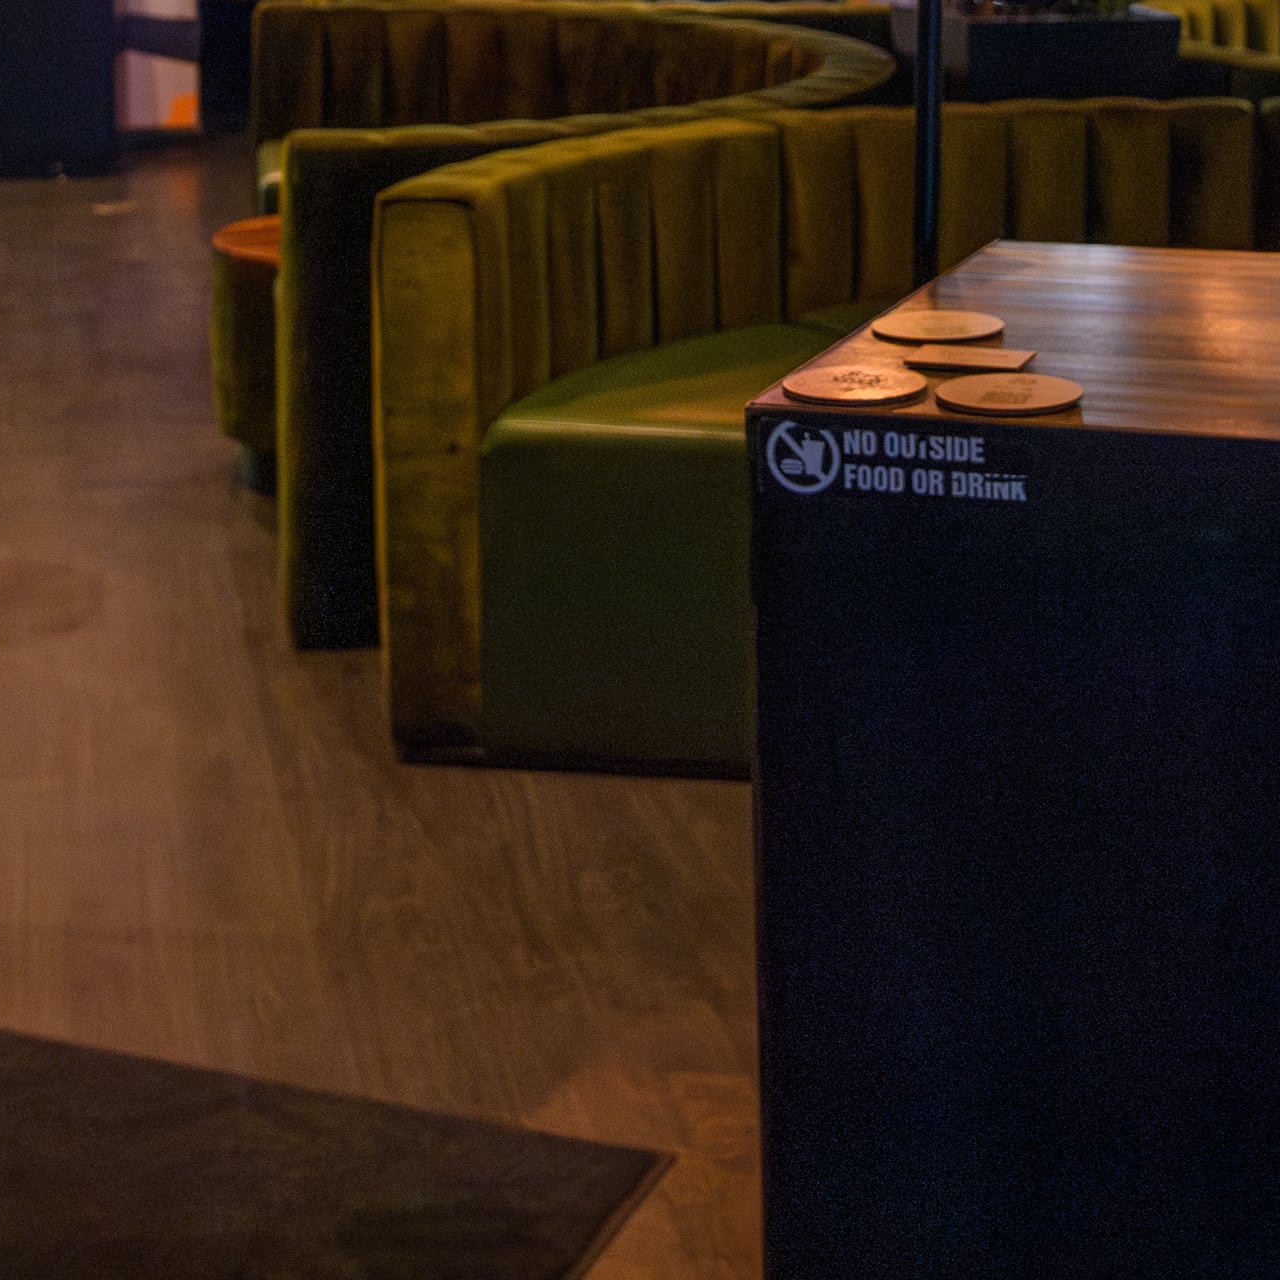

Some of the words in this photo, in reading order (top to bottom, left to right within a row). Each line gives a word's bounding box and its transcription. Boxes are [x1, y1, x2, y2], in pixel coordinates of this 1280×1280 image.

[842, 431, 878, 457] NO
[842, 464, 906, 493] FOOD
[911, 468, 944, 497] OR
[951, 472, 1028, 502] DRINK
